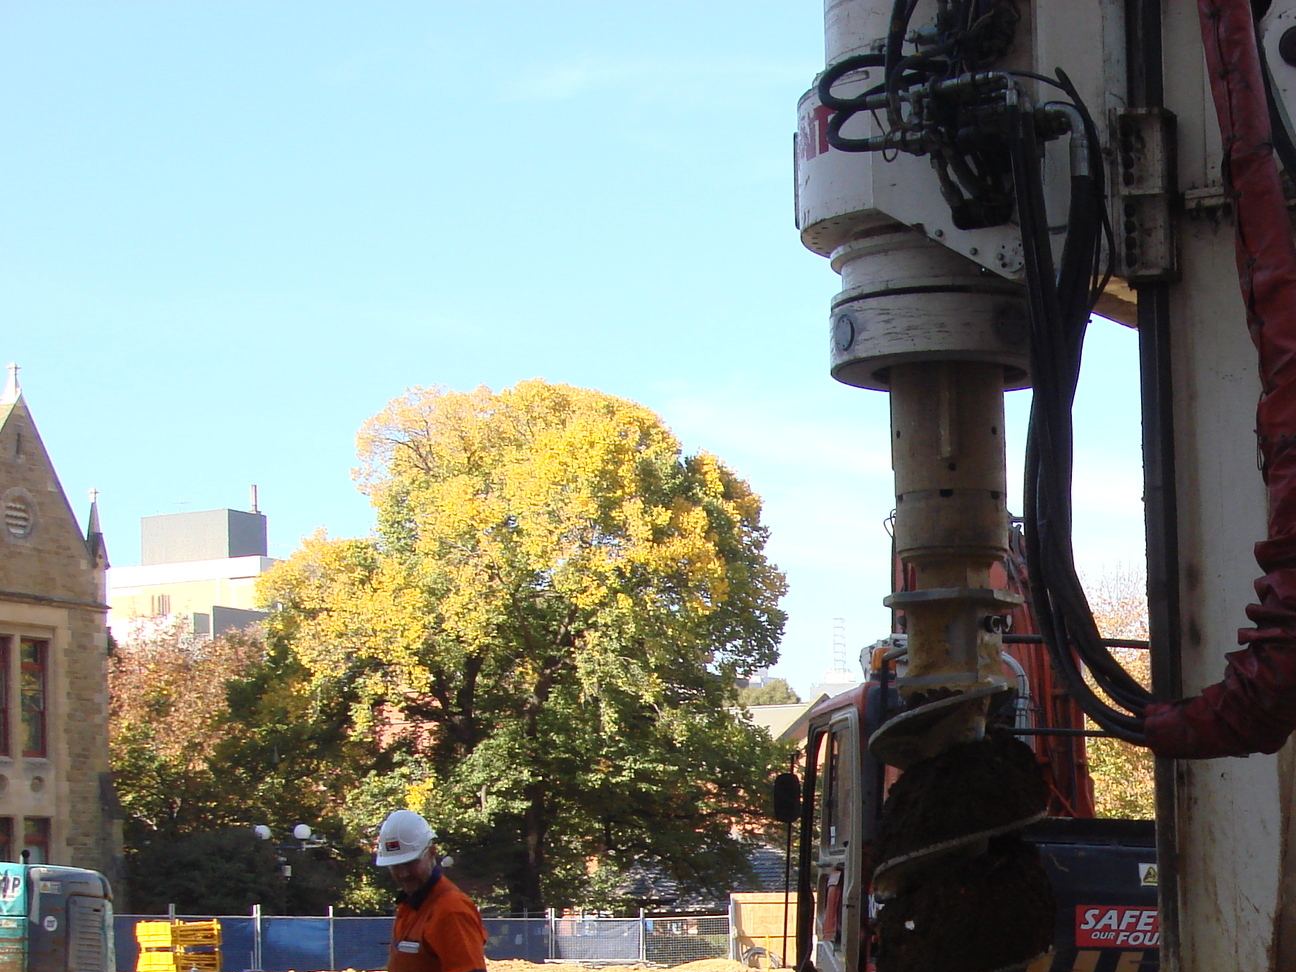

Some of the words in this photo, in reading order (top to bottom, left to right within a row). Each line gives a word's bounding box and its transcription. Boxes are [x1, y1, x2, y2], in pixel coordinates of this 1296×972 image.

[1080, 909, 1159, 931] SAFE
[1091, 931, 1116, 940] OUR
[1115, 932, 1160, 946] FOU
